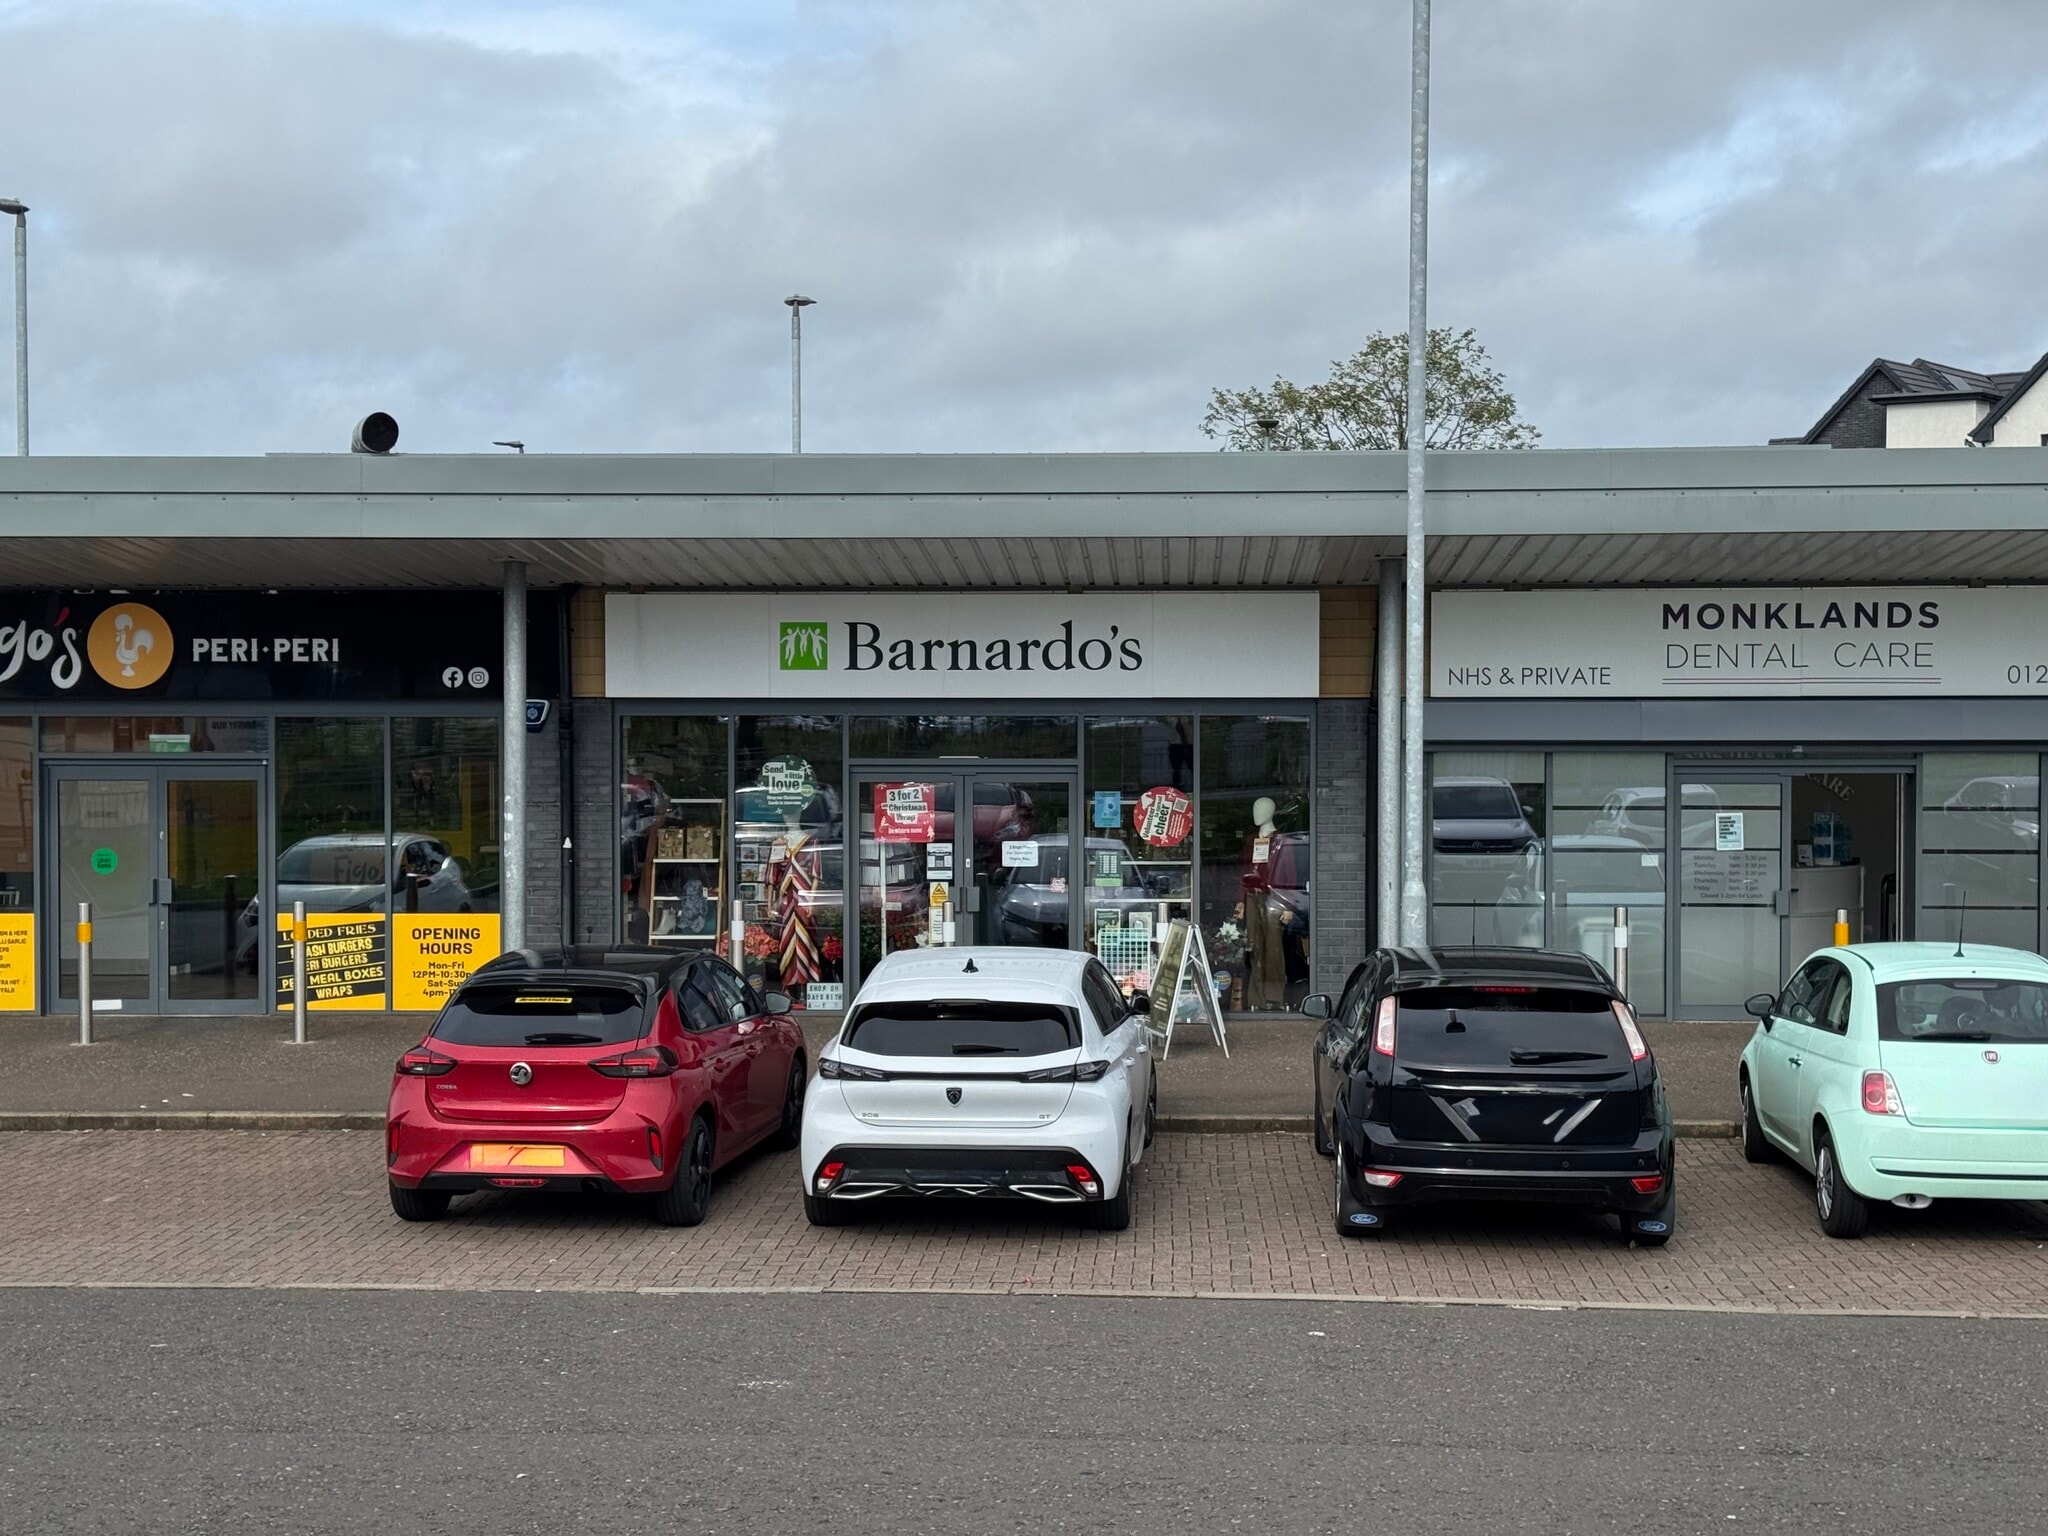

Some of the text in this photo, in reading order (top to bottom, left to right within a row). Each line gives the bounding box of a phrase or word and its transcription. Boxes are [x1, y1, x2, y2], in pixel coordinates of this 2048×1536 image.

[1662, 601, 1940, 630] MONKLANDS
[843, 619, 1143, 672] Barnardo's
[1666, 642, 1934, 669] DENTAL CARE
[1448, 666, 1612, 686] NHS & PRIVATE
[2007, 664, 2048, 684] 012
[764, 765, 784, 774] Send
[771, 776, 800, 791] love
[889, 788, 919, 801] 3 for 2
[889, 803, 927, 812] Christmas
[1155, 803, 1170, 836] cheer
[282, 923, 377, 942] LDED FRIES
[412, 928, 481, 940] OPENING
[327, 937, 374, 955] BURGERS
[420, 942, 473, 955] HOURS
[321, 953, 369, 970] BURGERS
[428, 961, 465, 970] Mon-Fri
[309, 971, 342, 986] MEAL
[344, 966, 384, 981] BOXES
[412, 970, 473, 980] 12PM-10:30p
[315, 985, 353, 999] WRAPS
